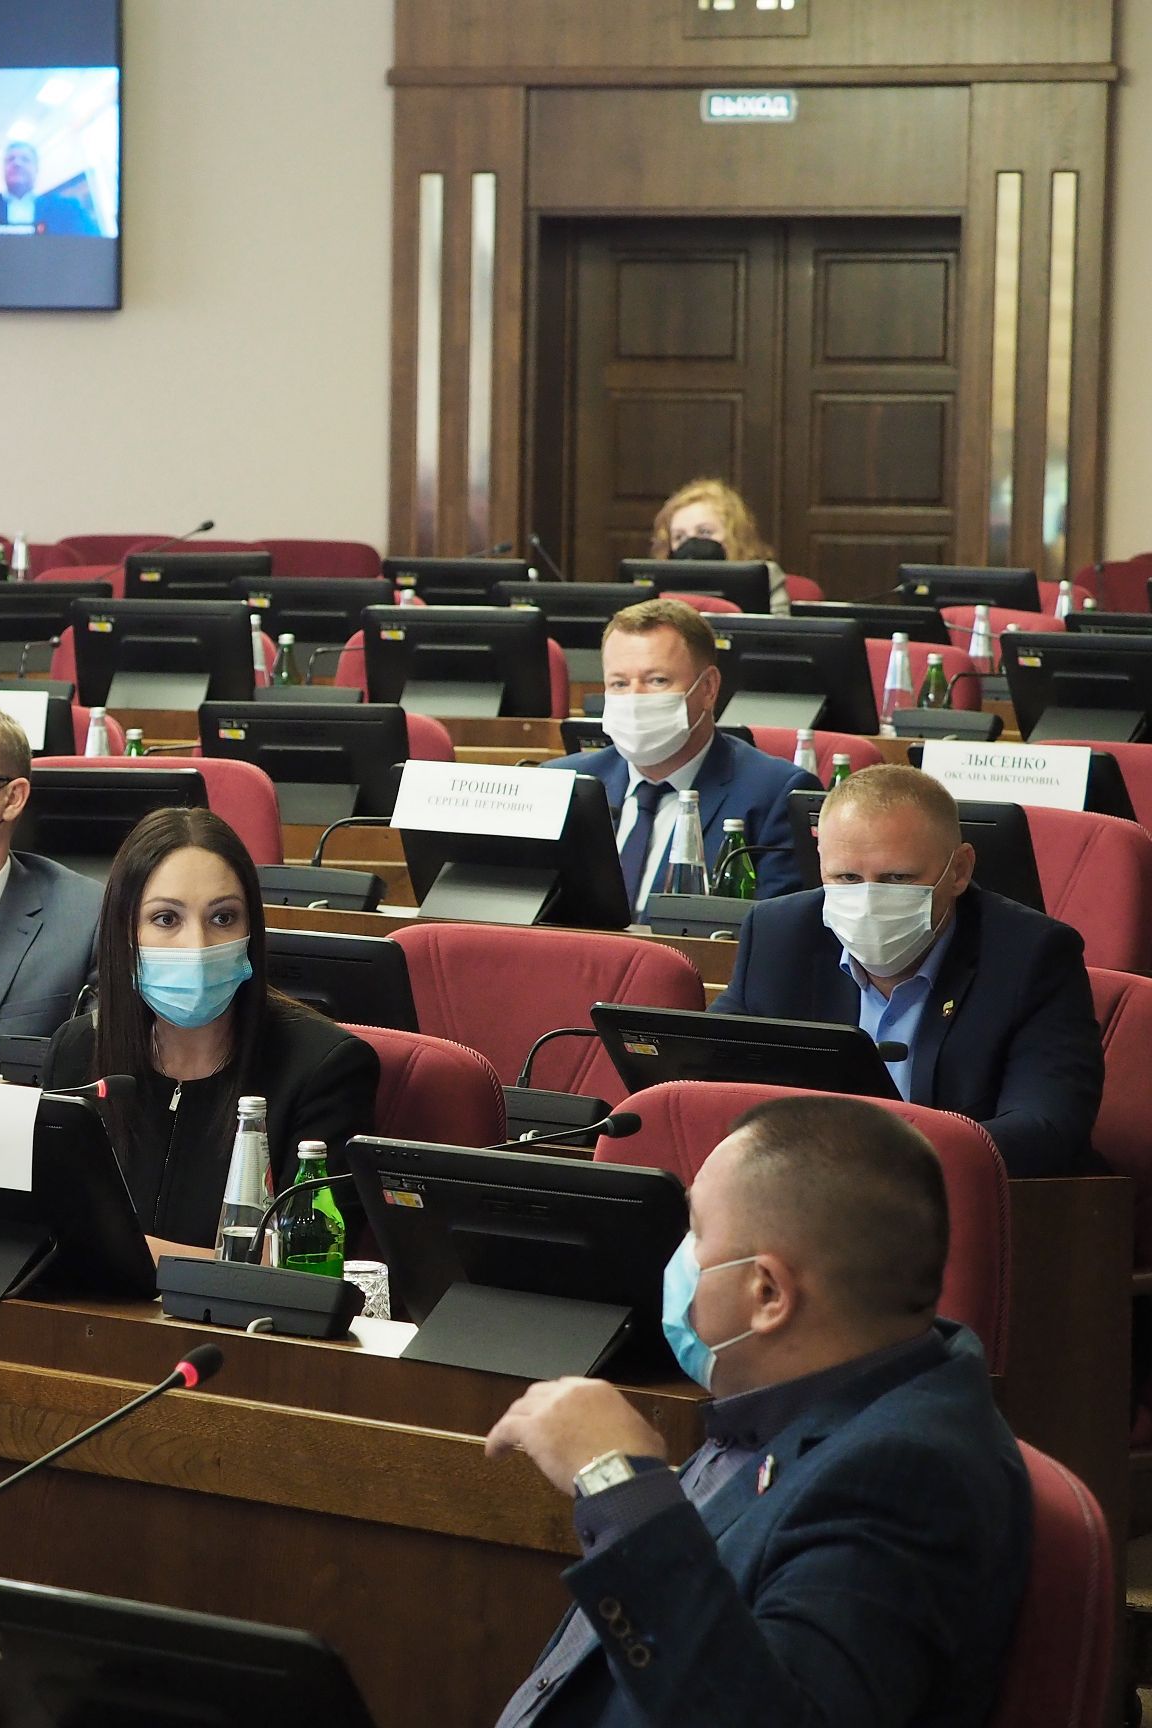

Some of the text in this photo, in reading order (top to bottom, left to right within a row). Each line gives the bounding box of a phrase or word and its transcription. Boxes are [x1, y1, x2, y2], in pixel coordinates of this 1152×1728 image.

[961, 754, 1047, 770] ЛЫСЕНКО
[944, 771, 1061, 786] ОКСАНА ВИКТОРОВНА
[450, 778, 519, 797] ТРОШИН
[474, 799, 535, 812] ПЕТРОВИЧ
